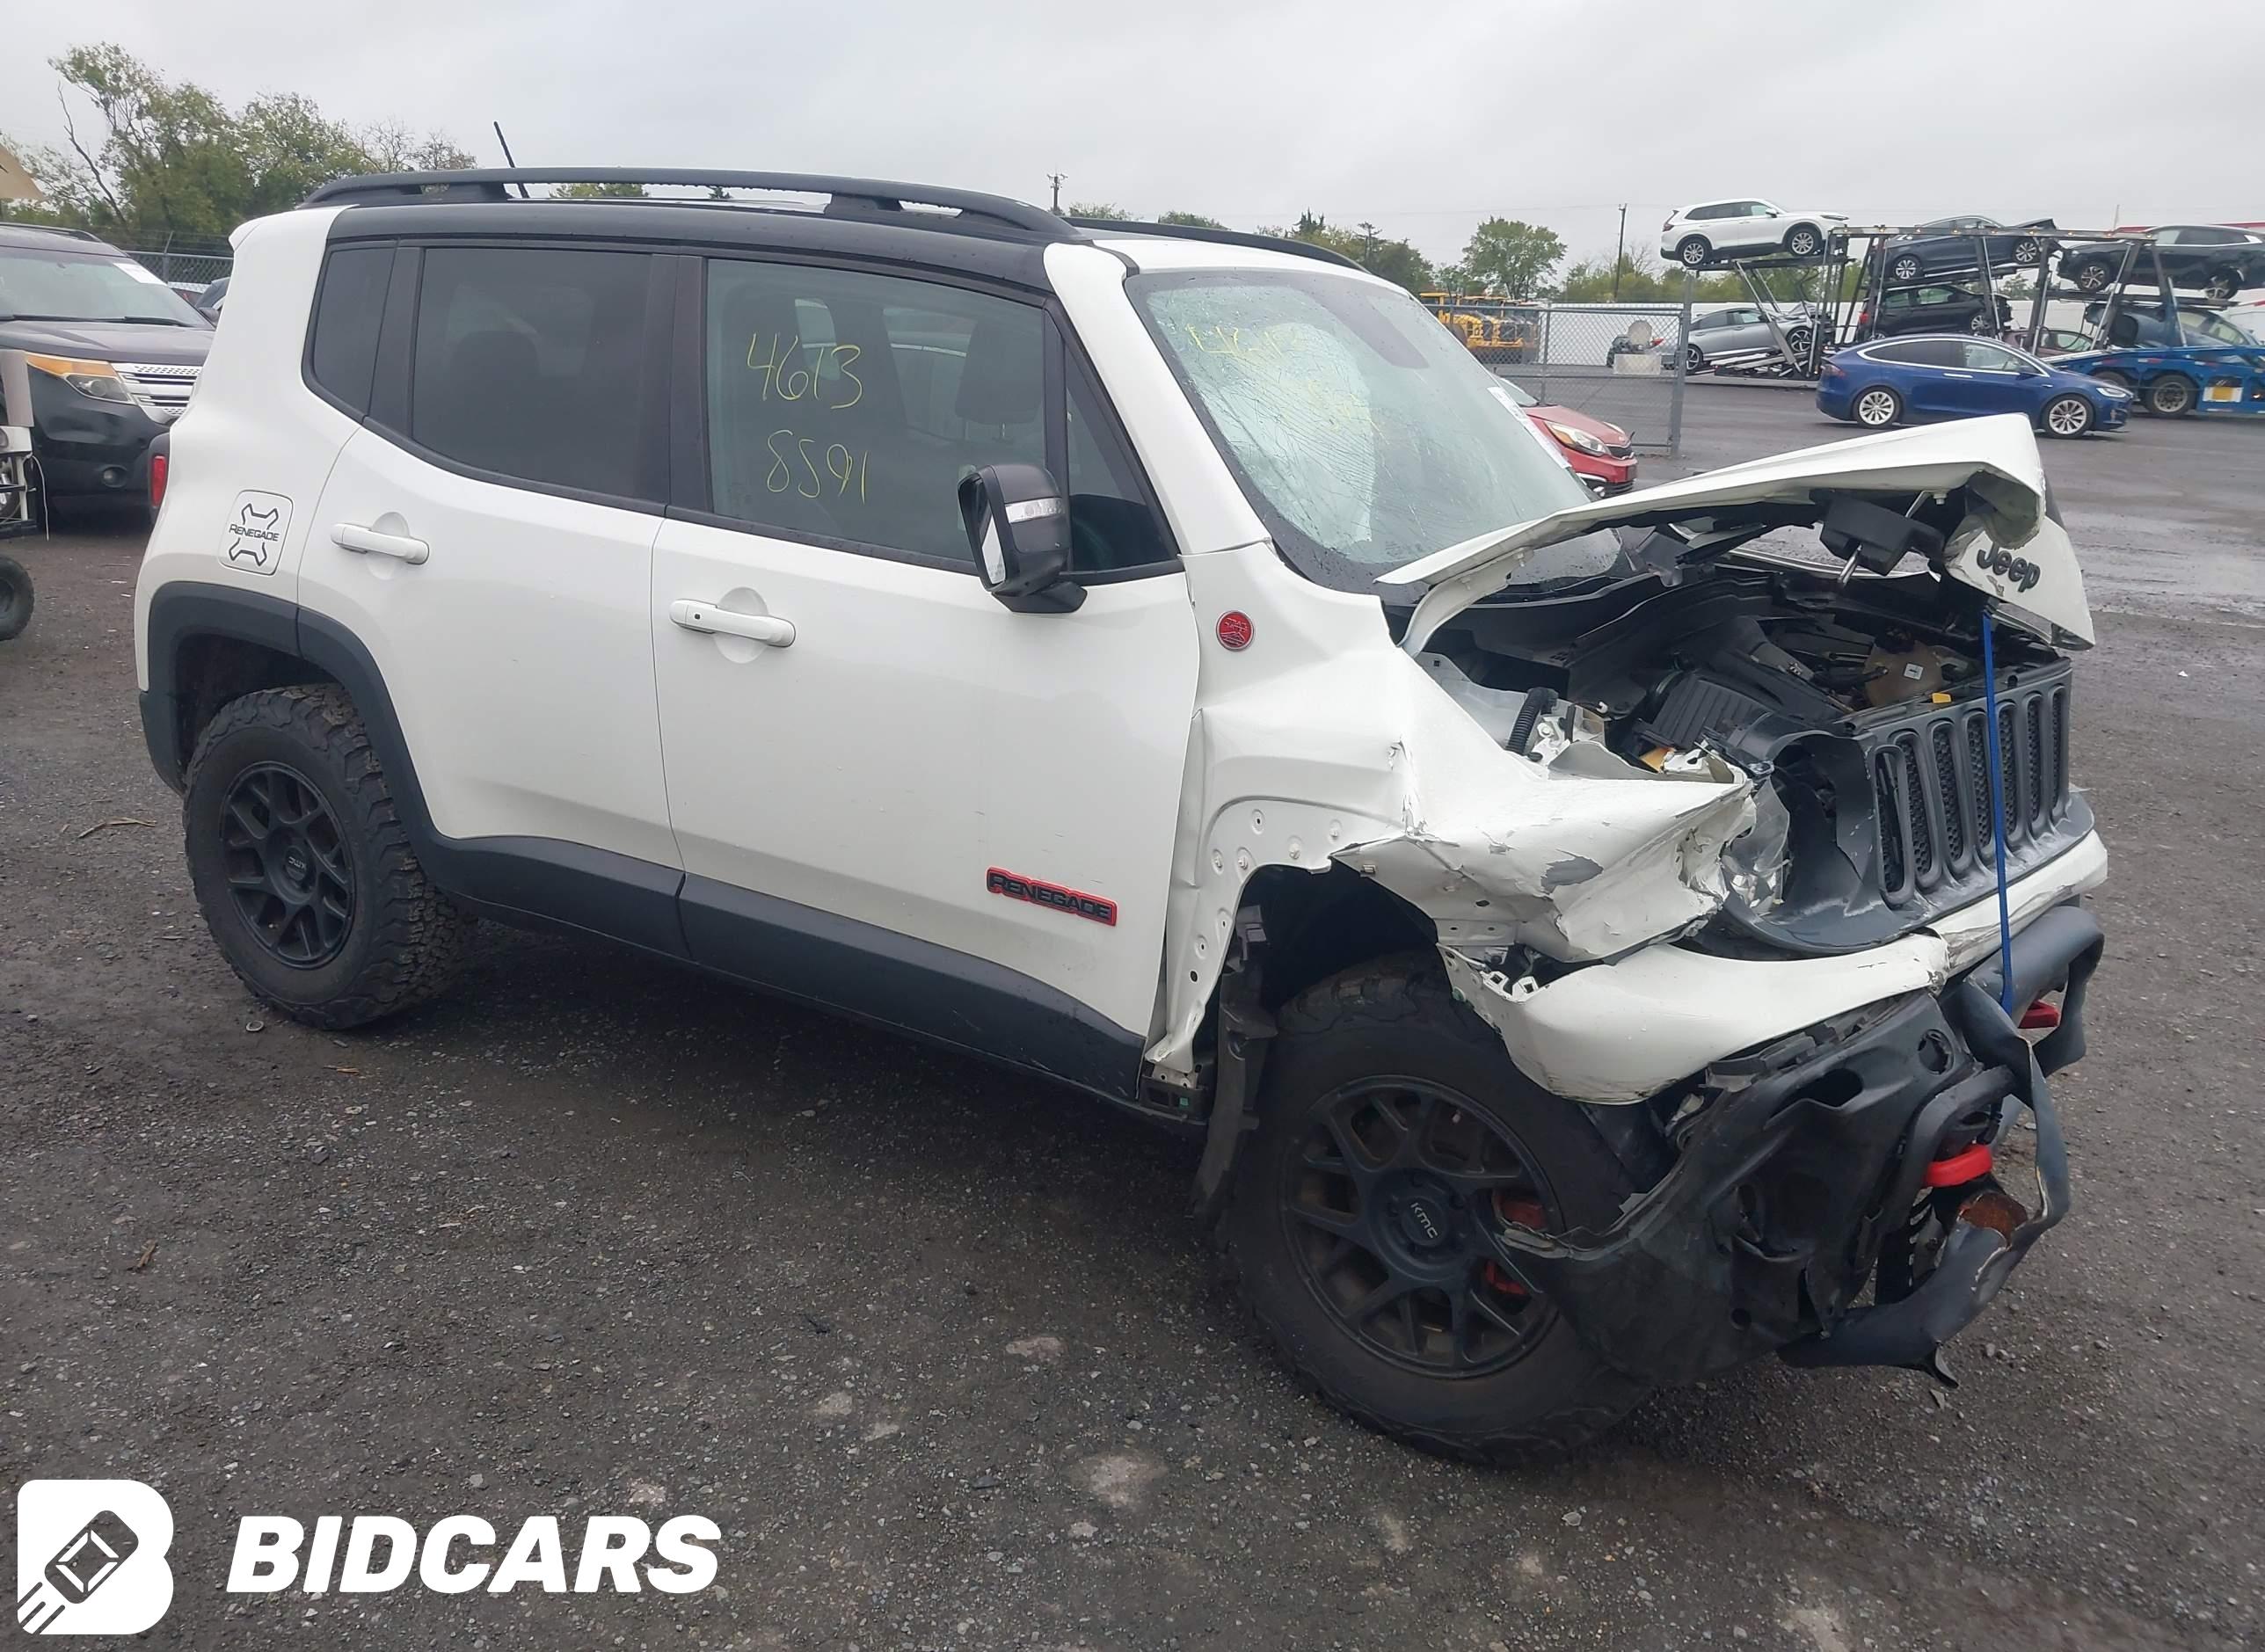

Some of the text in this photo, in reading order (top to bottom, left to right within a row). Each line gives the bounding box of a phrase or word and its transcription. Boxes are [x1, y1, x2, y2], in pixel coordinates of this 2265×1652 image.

[747, 332, 863, 410] 4613
[767, 429, 869, 505] 8591
[229, 523, 280, 542] RENEGADE
[1977, 542, 2041, 593] Jeep
[987, 870, 1114, 921] RENEGADE
